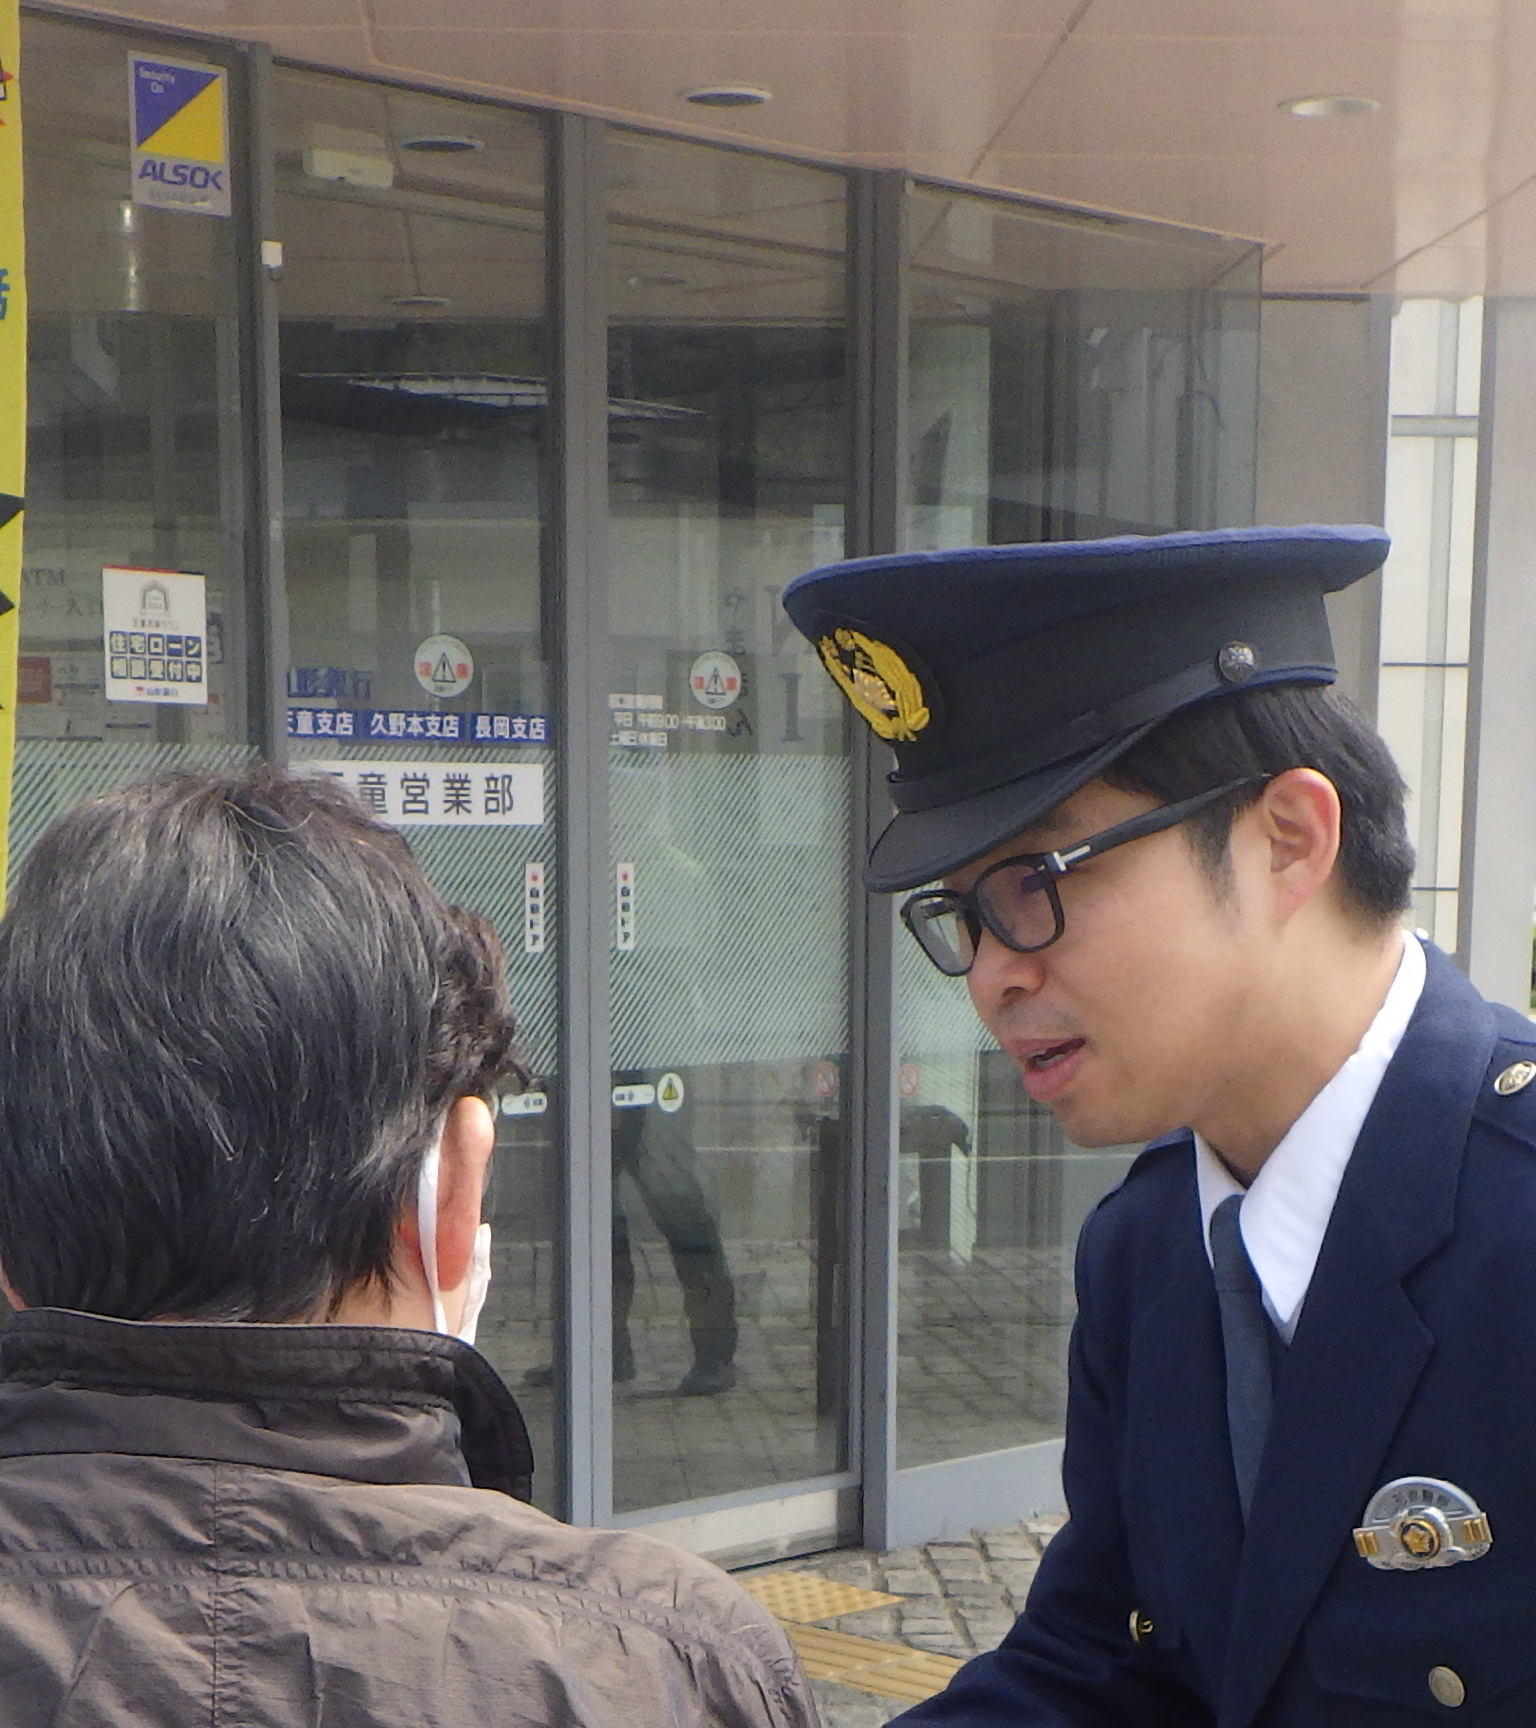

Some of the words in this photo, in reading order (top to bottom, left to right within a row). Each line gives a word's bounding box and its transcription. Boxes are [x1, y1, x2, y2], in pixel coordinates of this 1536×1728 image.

[138, 159, 223, 191] ALSOK
[111, 632, 202, 657] 住宅ローン
[370, 713, 459, 738] 久野本支店
[475, 715, 546, 740] 長岡支店
[330, 771, 514, 815] 童営業部
